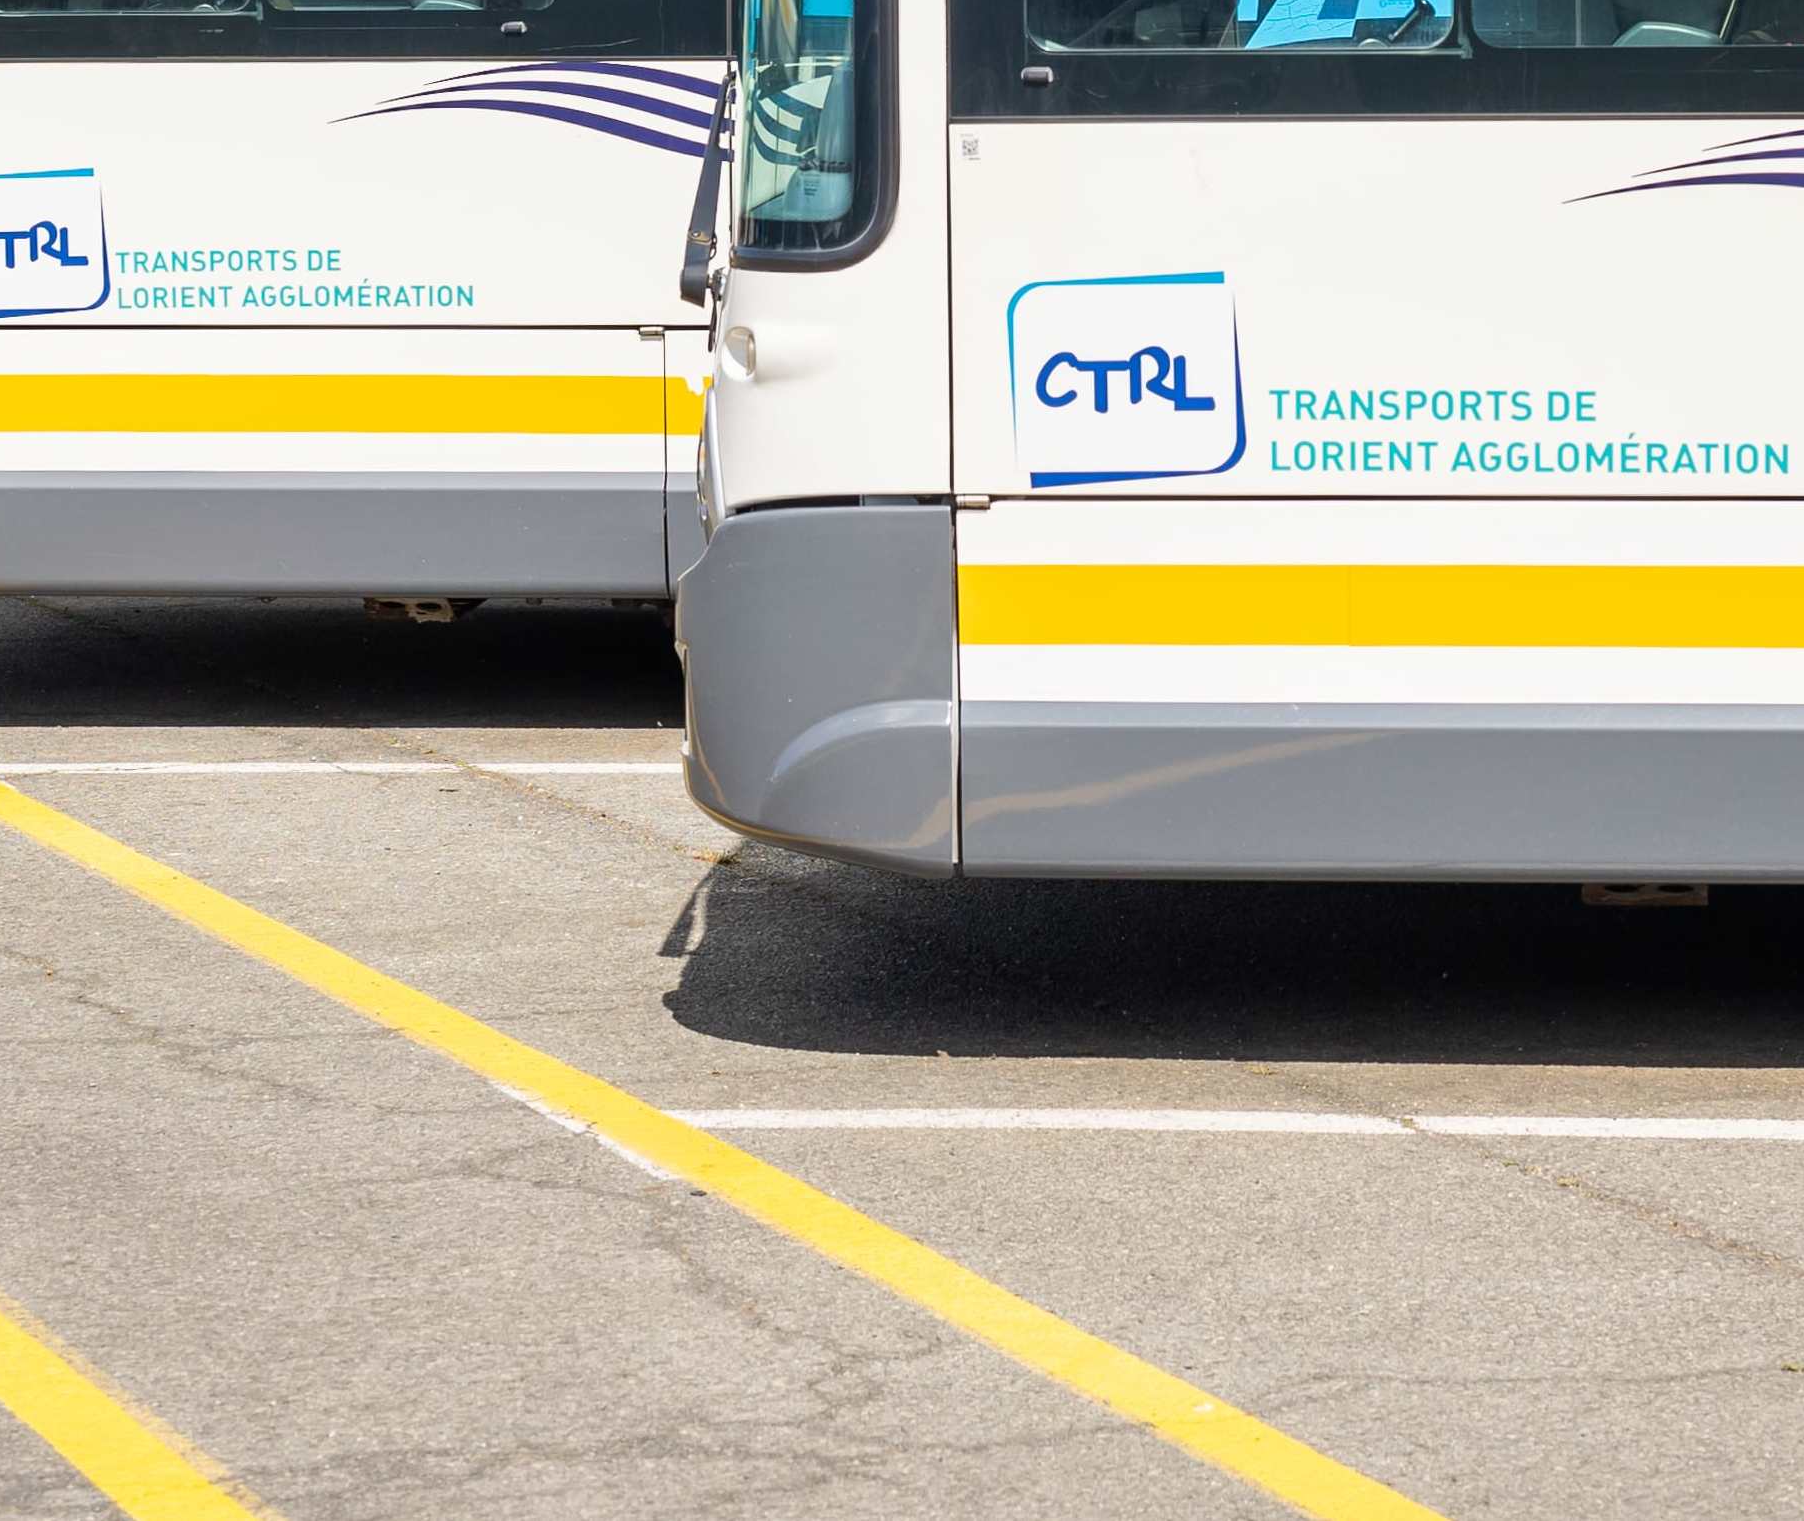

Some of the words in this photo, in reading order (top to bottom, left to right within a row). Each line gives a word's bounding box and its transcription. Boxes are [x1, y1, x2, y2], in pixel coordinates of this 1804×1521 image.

[116, 248, 298, 274] TRANSPORTS
[307, 249, 341, 272] DE
[117, 285, 232, 310] LORIENT
[241, 278, 475, 310] AGGLOMÉRATION
[1035, 346, 1215, 414] CTRL
[1269, 389, 1534, 423] TRANSPORTS
[1547, 390, 1597, 423] DE
[1270, 440, 1439, 473] LORIENT
[1451, 431, 1790, 475] AGGLOMÉRATION
